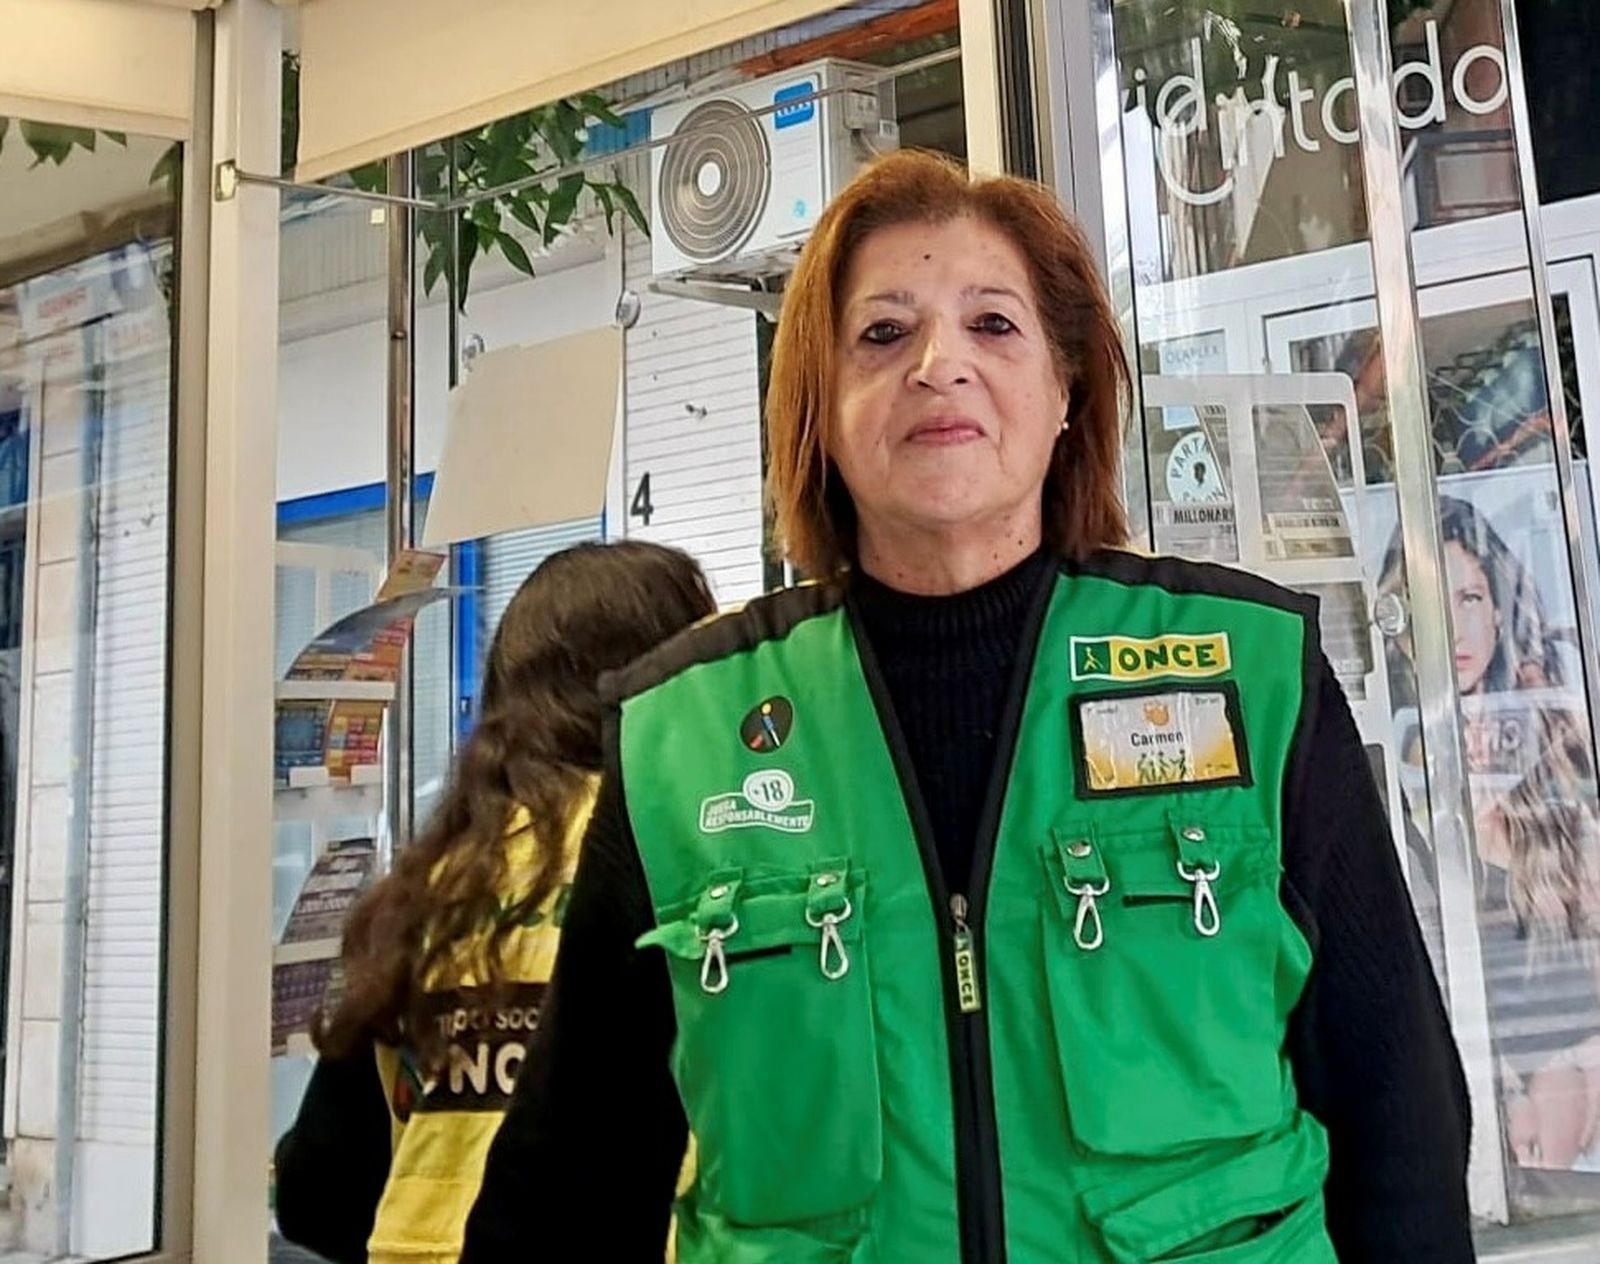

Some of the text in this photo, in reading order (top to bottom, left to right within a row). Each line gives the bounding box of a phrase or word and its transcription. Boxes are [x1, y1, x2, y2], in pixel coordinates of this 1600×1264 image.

[630, 471, 654, 526] 4
[1118, 643, 1217, 671] ONCE
[1131, 731, 1184, 747] Carmen
[958, 954, 973, 1004] ONCE
